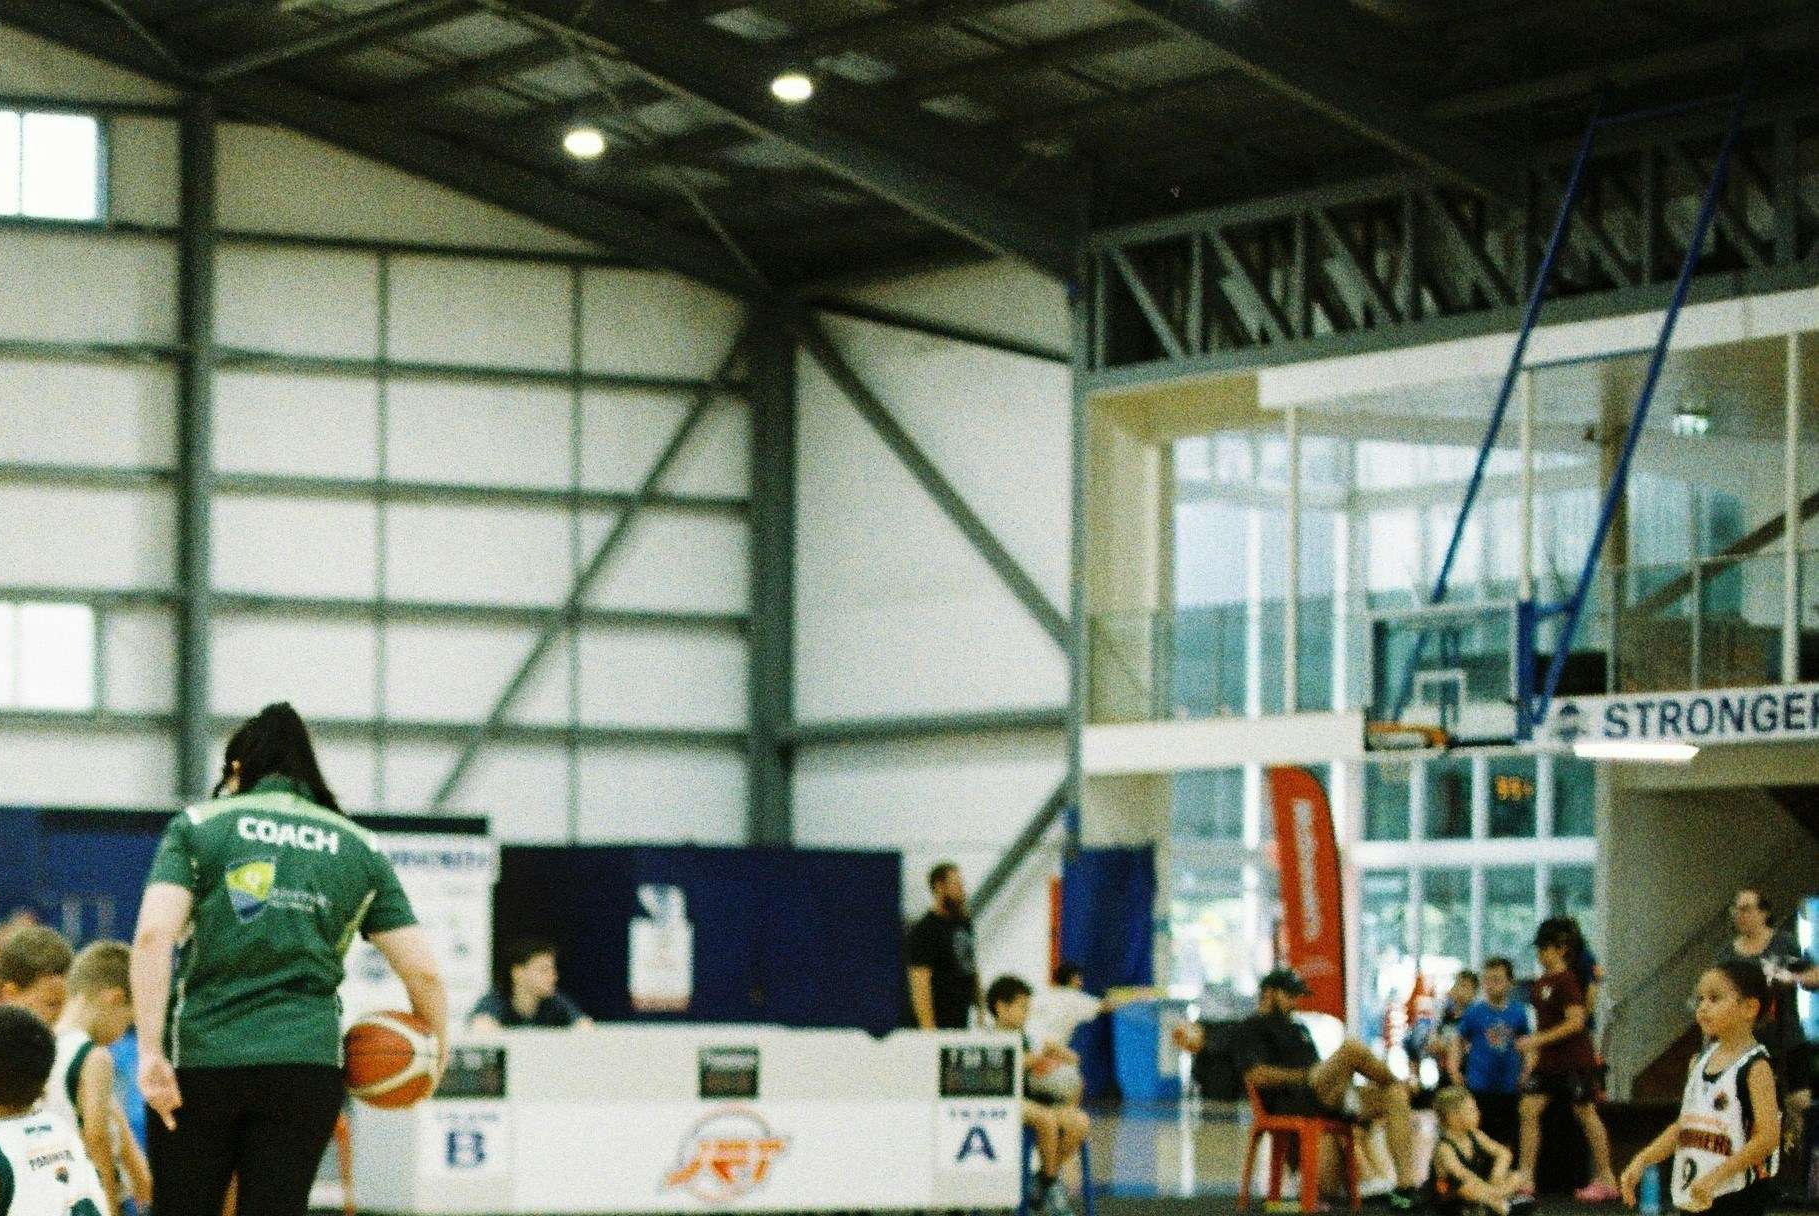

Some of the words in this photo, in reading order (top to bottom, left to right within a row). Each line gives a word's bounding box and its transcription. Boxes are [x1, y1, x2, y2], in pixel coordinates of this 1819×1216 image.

[1604, 692, 1819, 738] STRONGE
[237, 817, 339, 855] COACH
[445, 1129, 486, 1168] B
[955, 1123, 998, 1162] A
